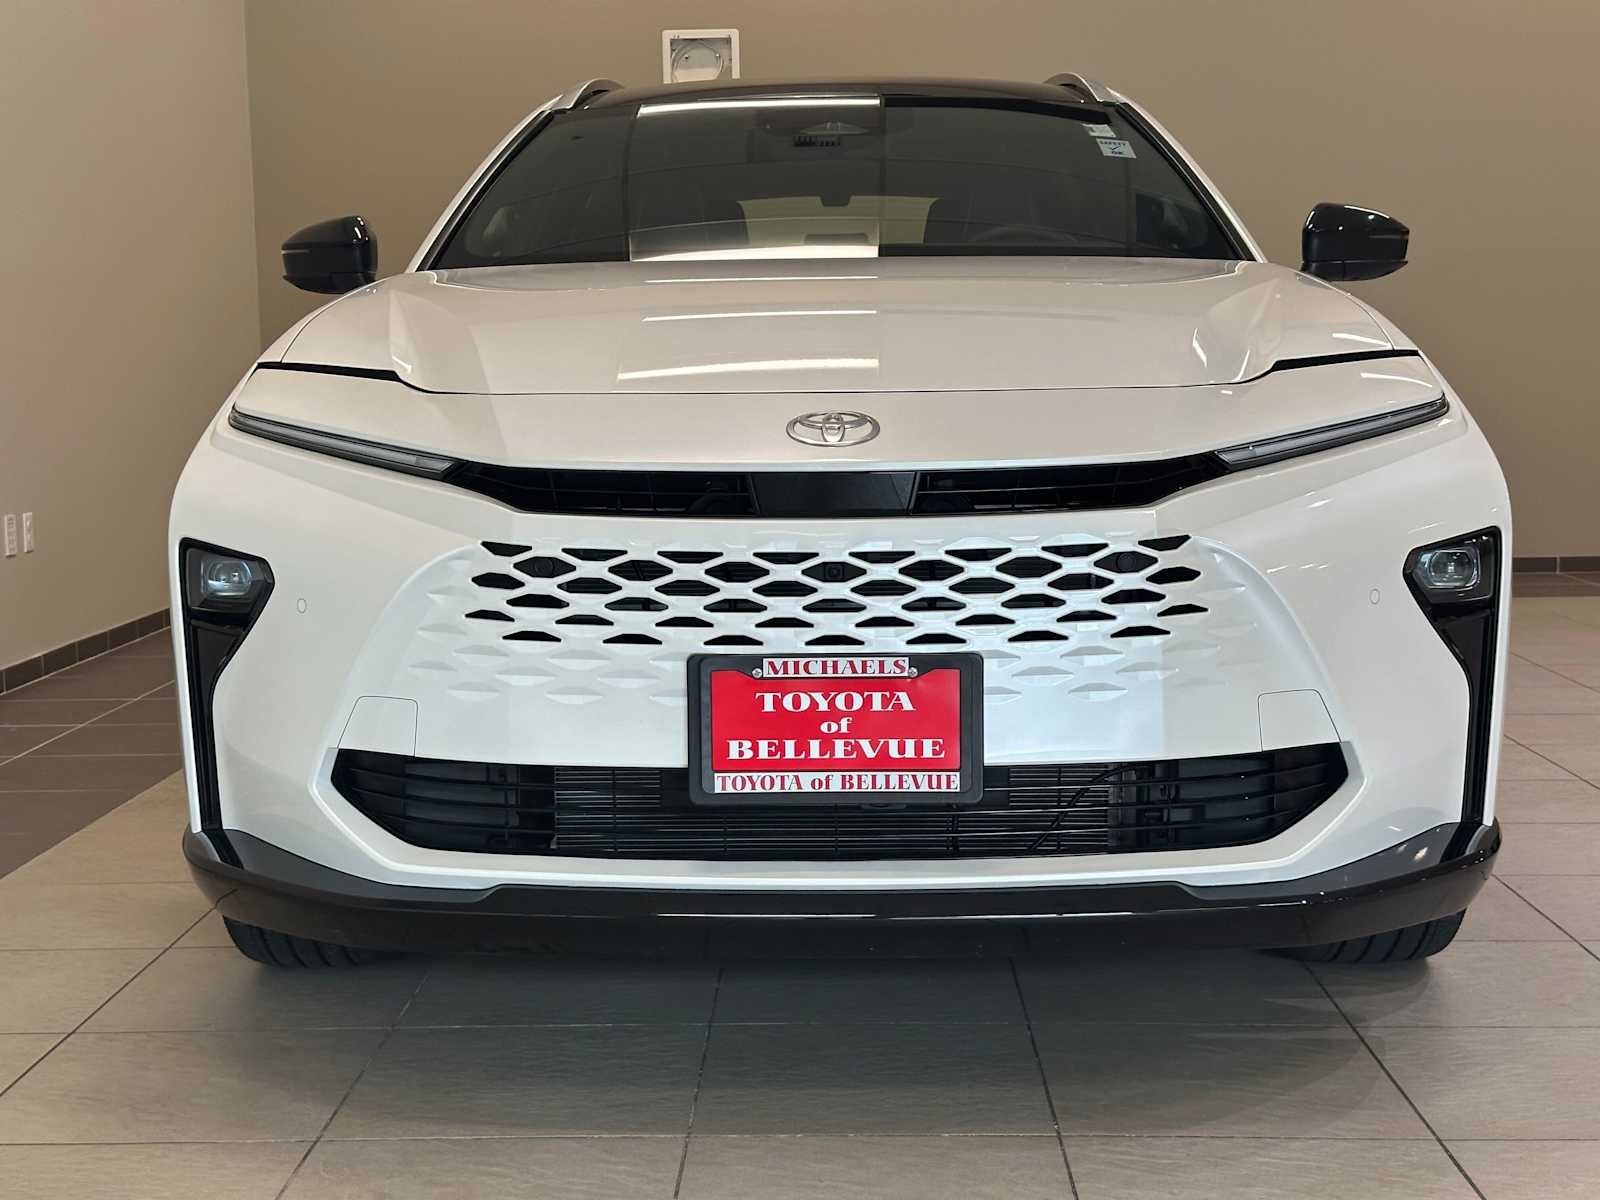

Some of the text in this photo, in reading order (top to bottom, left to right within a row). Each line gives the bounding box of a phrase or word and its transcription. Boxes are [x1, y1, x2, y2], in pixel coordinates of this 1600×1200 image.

[766, 659, 907, 675] MICHAELS
[755, 691, 916, 712] TOYOTA
[819, 717, 853, 734] of
[727, 738, 945, 760] BELLEVUE
[716, 774, 958, 791] TOYOTA of BELLEVUE
